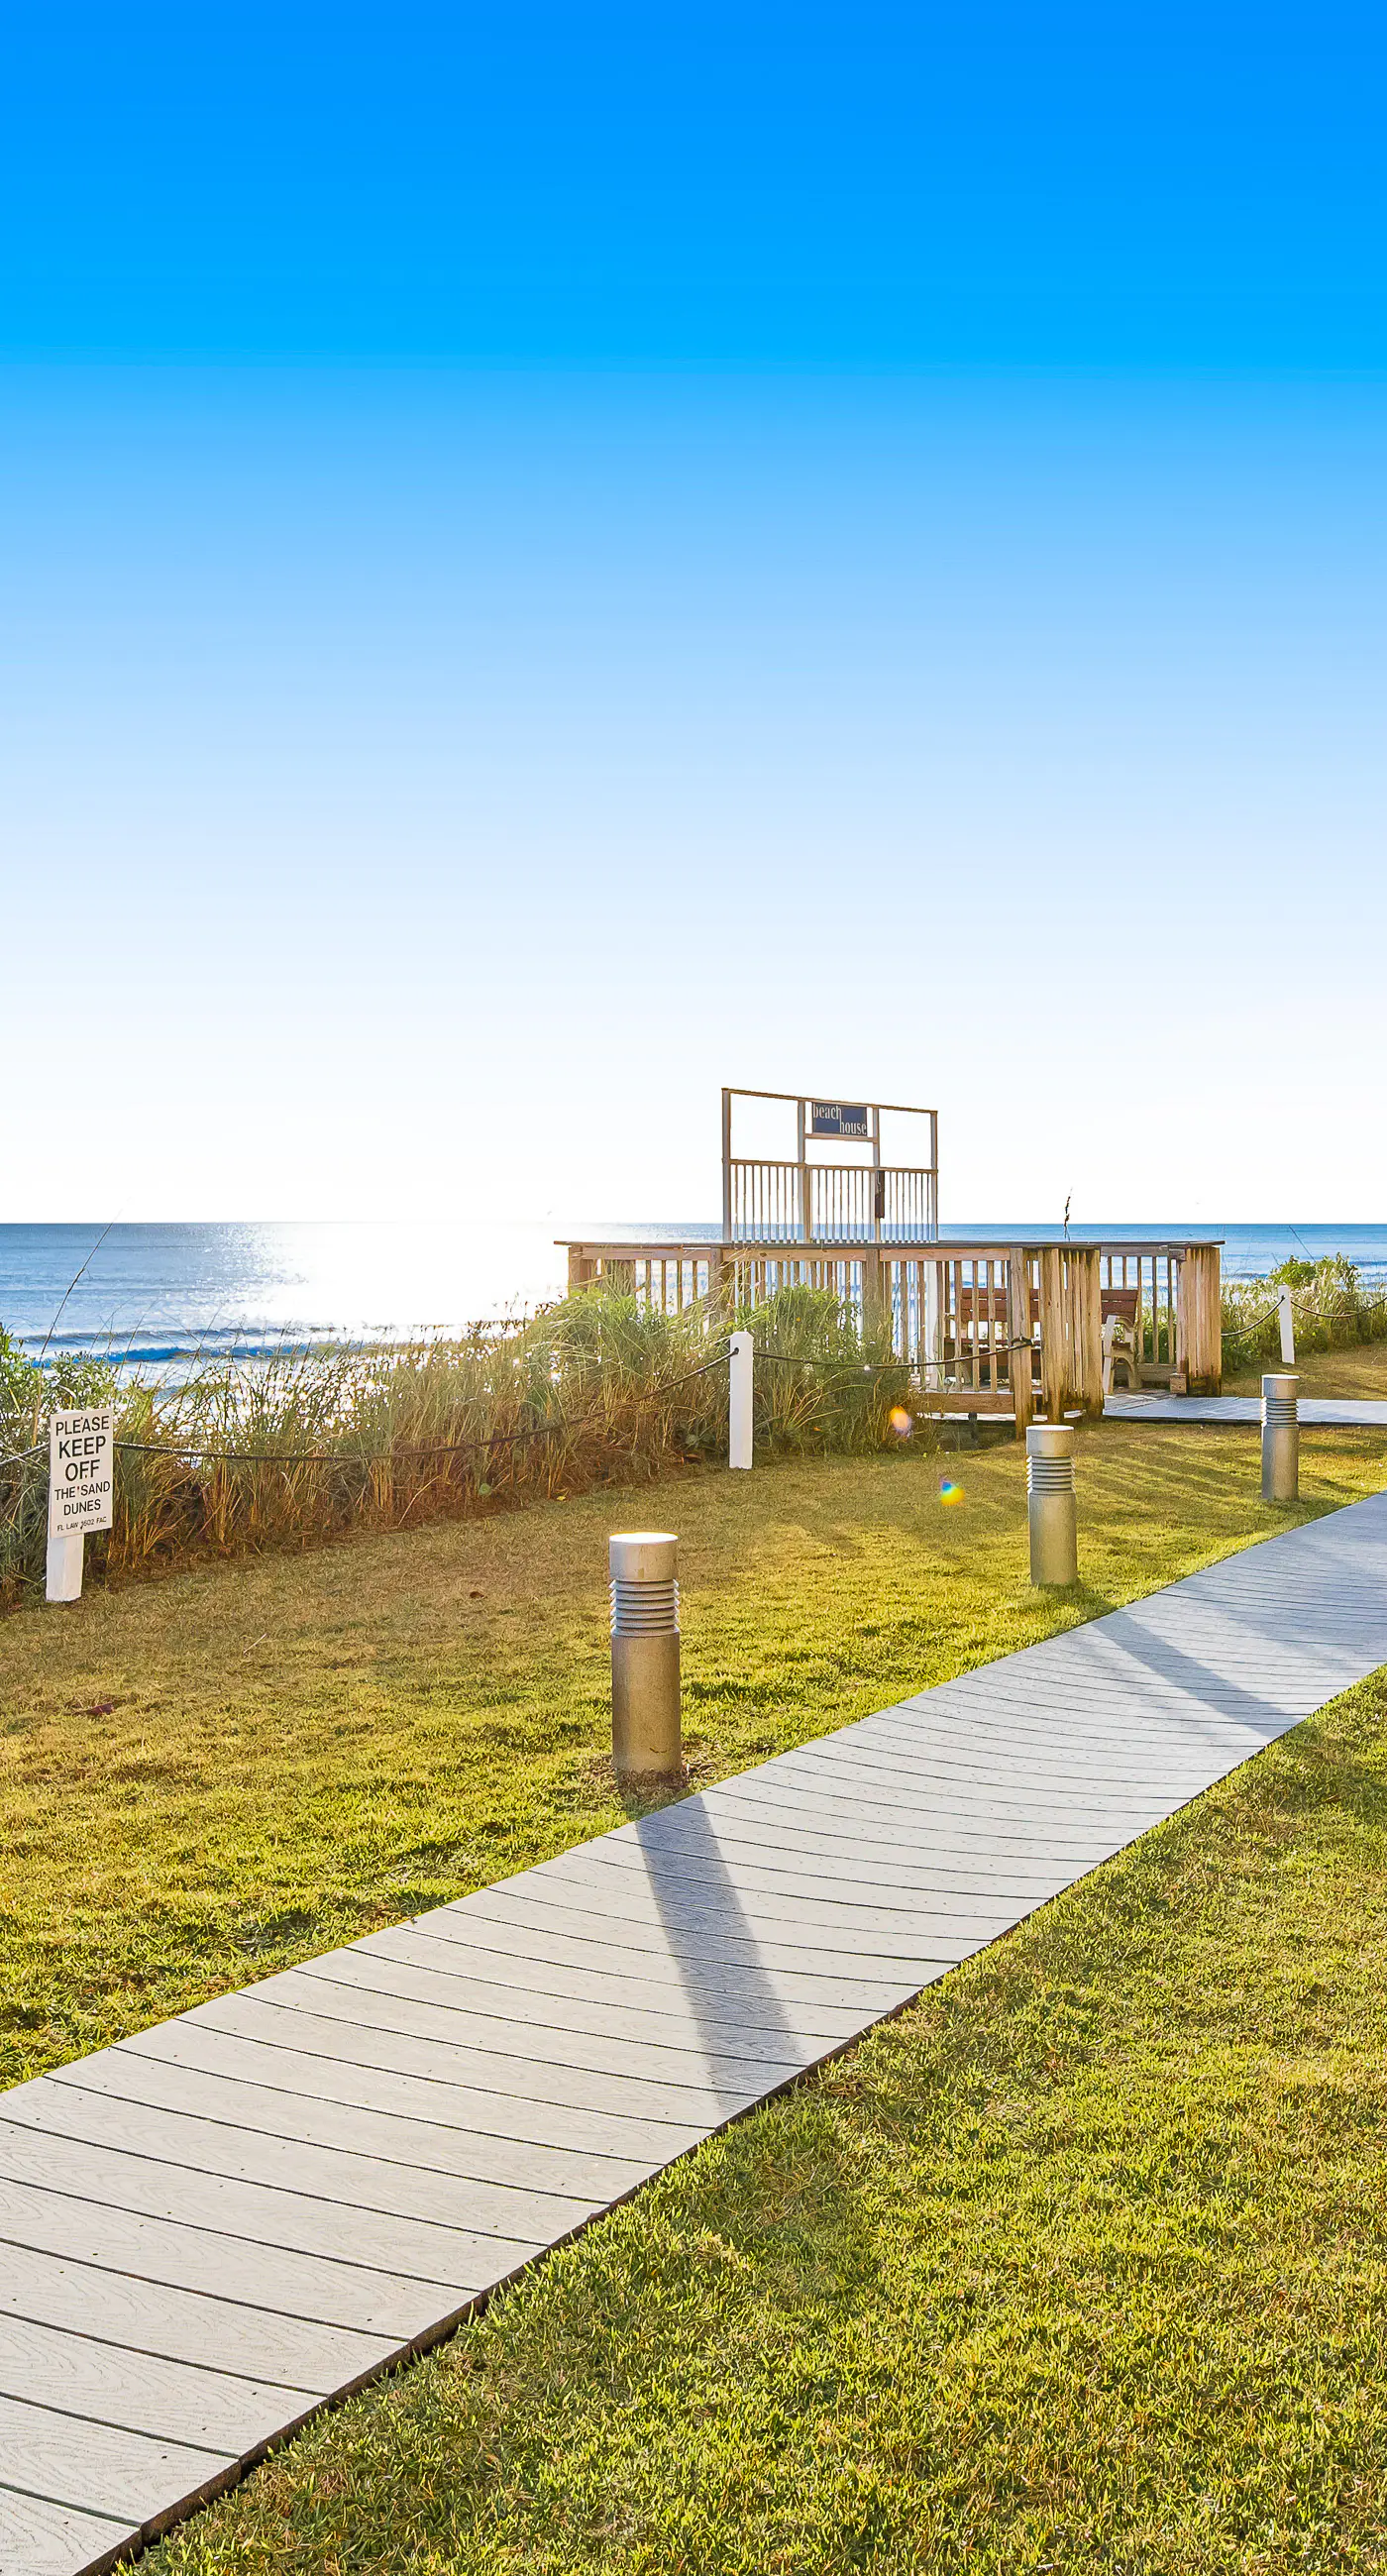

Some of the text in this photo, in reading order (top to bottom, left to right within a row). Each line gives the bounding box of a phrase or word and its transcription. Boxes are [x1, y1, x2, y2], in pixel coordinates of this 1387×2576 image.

[813, 1102, 841, 1120] beach
[839, 1122, 867, 1135] house
[55, 1416, 110, 1437] PLEASE
[59, 1436, 106, 1459] KEEP
[65, 1459, 100, 1481] OFF
[54, 1481, 111, 1500] THE SAND
[63, 1499, 101, 1516] DUNES
